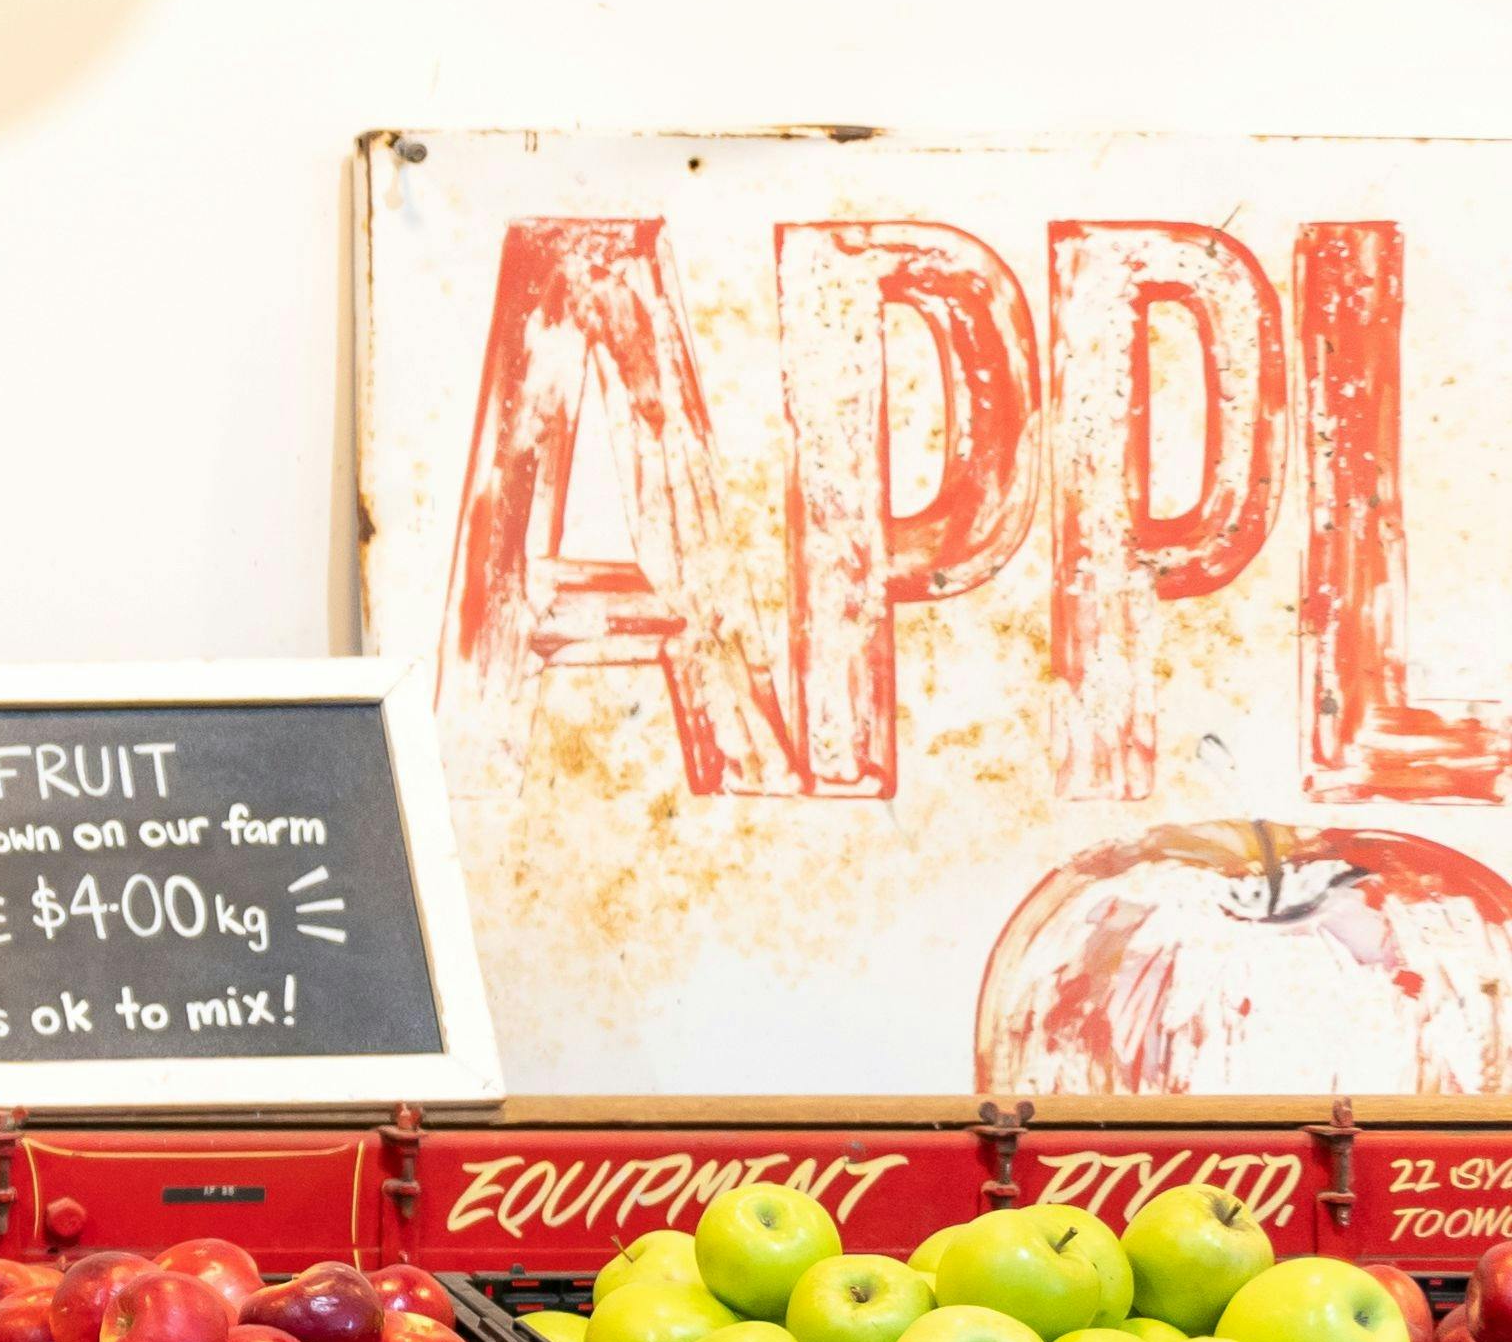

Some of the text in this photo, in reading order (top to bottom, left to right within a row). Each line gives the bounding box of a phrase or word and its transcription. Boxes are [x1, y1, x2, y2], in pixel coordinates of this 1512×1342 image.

[436, 215, 1508, 804] APPL
[73, 816, 126, 852] on
[139, 811, 210, 849] our
[221, 804, 326, 847] farm
[32, 992, 93, 1034] ok
[115, 985, 170, 1031] to
[187, 974, 298, 1031] mix!
[1037, 1149, 1193, 1223] PTY
[1389, 1157, 1512, 1193] 22 SY
